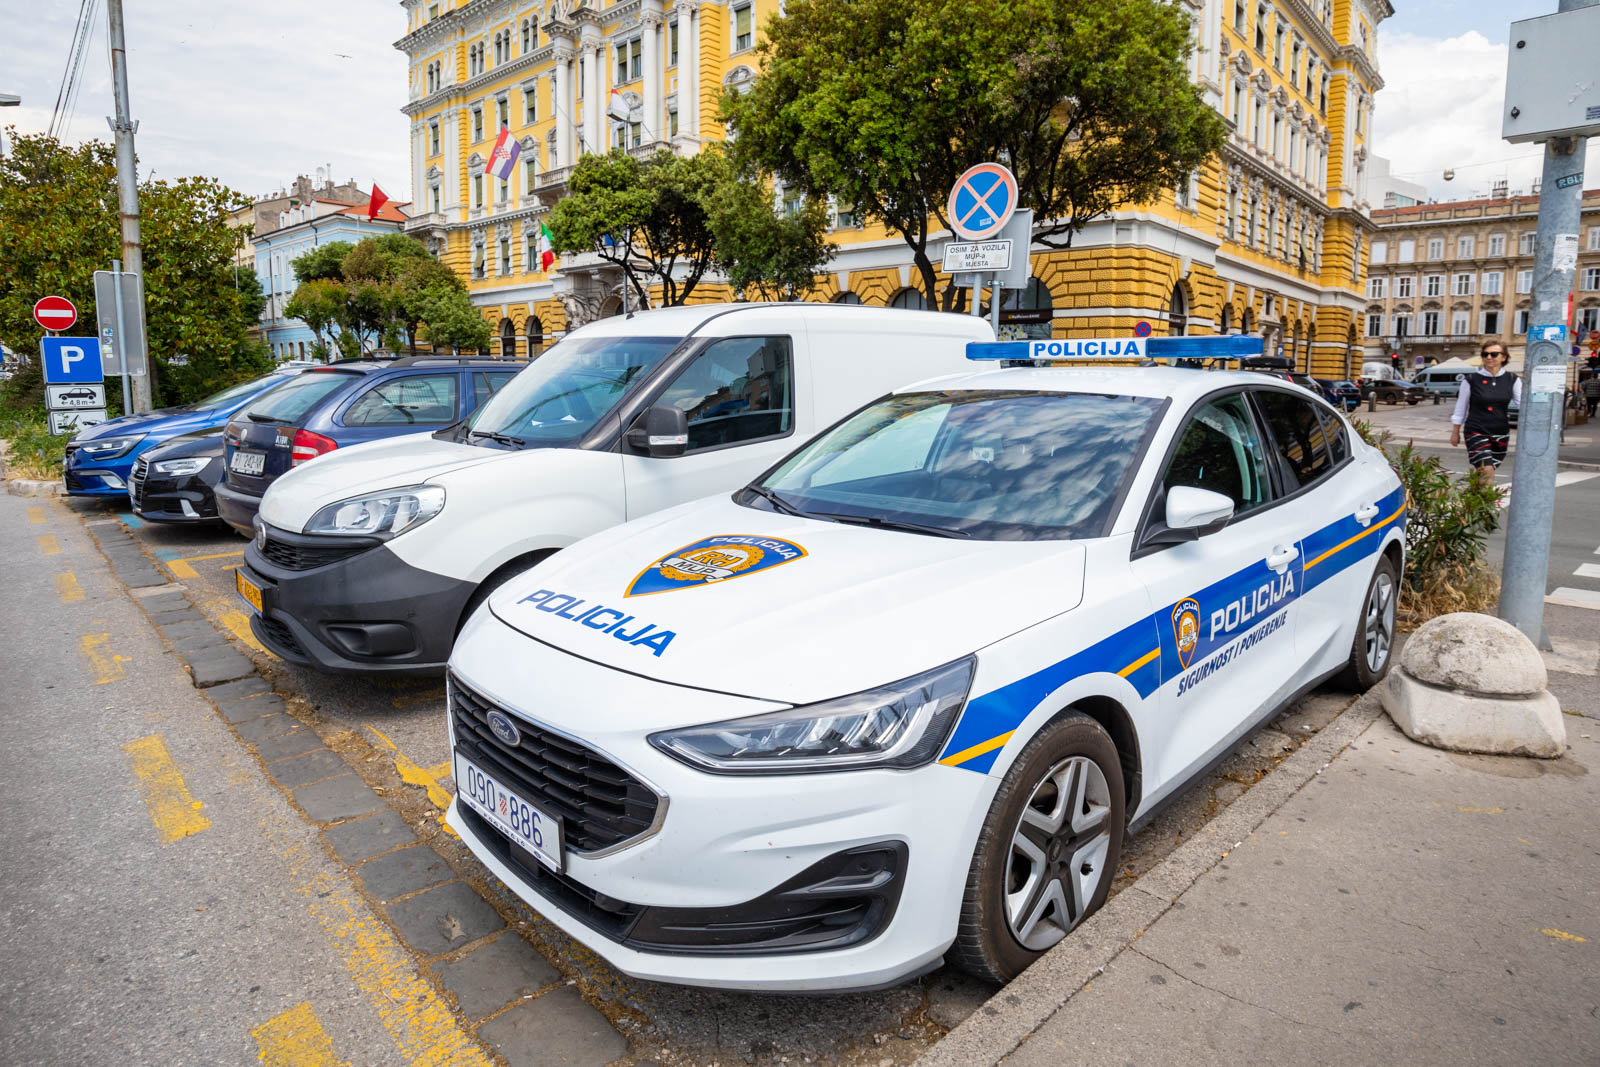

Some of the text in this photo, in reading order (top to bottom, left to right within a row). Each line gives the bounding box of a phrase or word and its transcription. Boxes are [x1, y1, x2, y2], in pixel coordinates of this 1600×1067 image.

[950, 246, 967, 254] OSIM
[982, 243, 1006, 251] VOZILA
[60, 346, 85, 373] P
[1033, 341, 1140, 357] POLICIJA
[693, 550, 742, 567] RH
[710, 536, 798, 560] POLICIJA
[674, 560, 716, 575] MUP
[1174, 602, 1198, 622] POLICIJA
[1210, 570, 1294, 642] POLICIJA
[516, 589, 677, 657] POLICIJA
[1177, 610, 1288, 697] SIGURNOST I POVJERENJE
[492, 717, 510, 740] Ford
[468, 766, 496, 812] 090
[510, 796, 543, 847] 886
